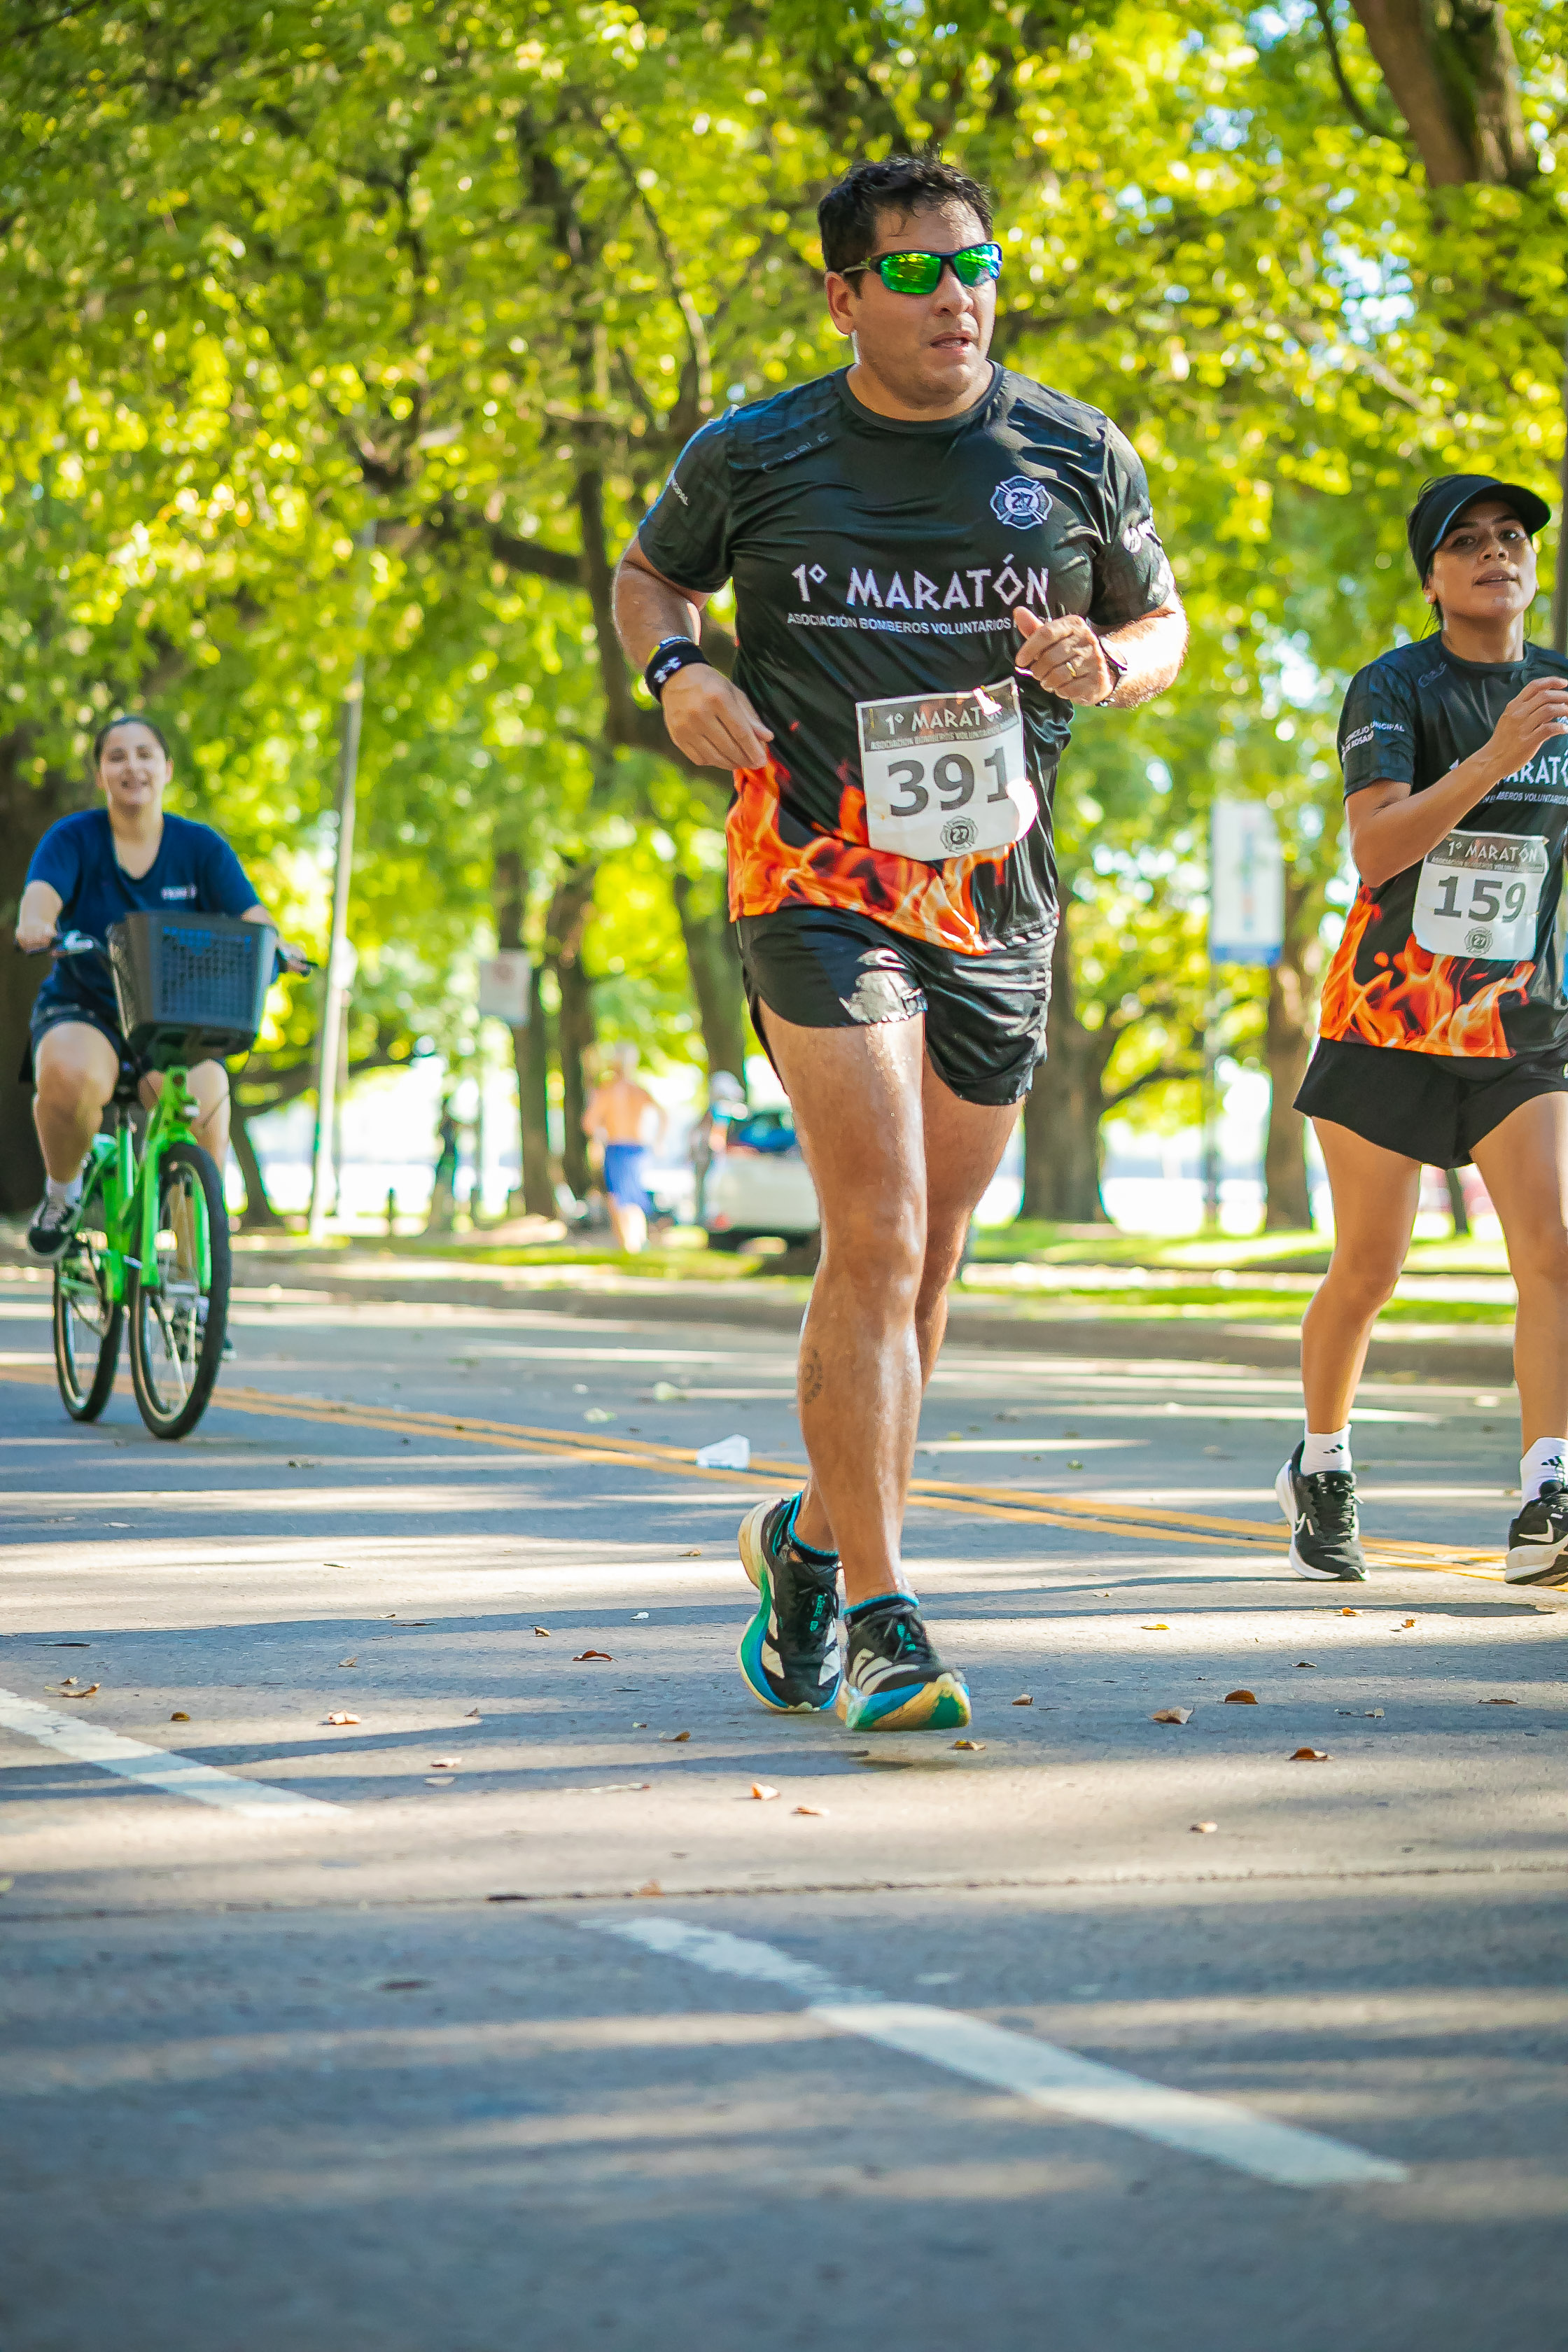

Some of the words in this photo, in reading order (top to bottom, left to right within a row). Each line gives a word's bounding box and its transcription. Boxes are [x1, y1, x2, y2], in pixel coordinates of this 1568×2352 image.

[1011, 492, 1033, 508] 27
[846, 553, 1049, 610] MARATÓN
[930, 617, 1011, 635] VOLUNTARIOS
[911, 705, 1002, 733] MARAT
[1370, 719, 1405, 732] UNICIPAL
[888, 746, 1009, 818] 391
[953, 828, 967, 842] 27
[1464, 842, 1538, 863] MARATÓN
[1434, 876, 1526, 923] 159
